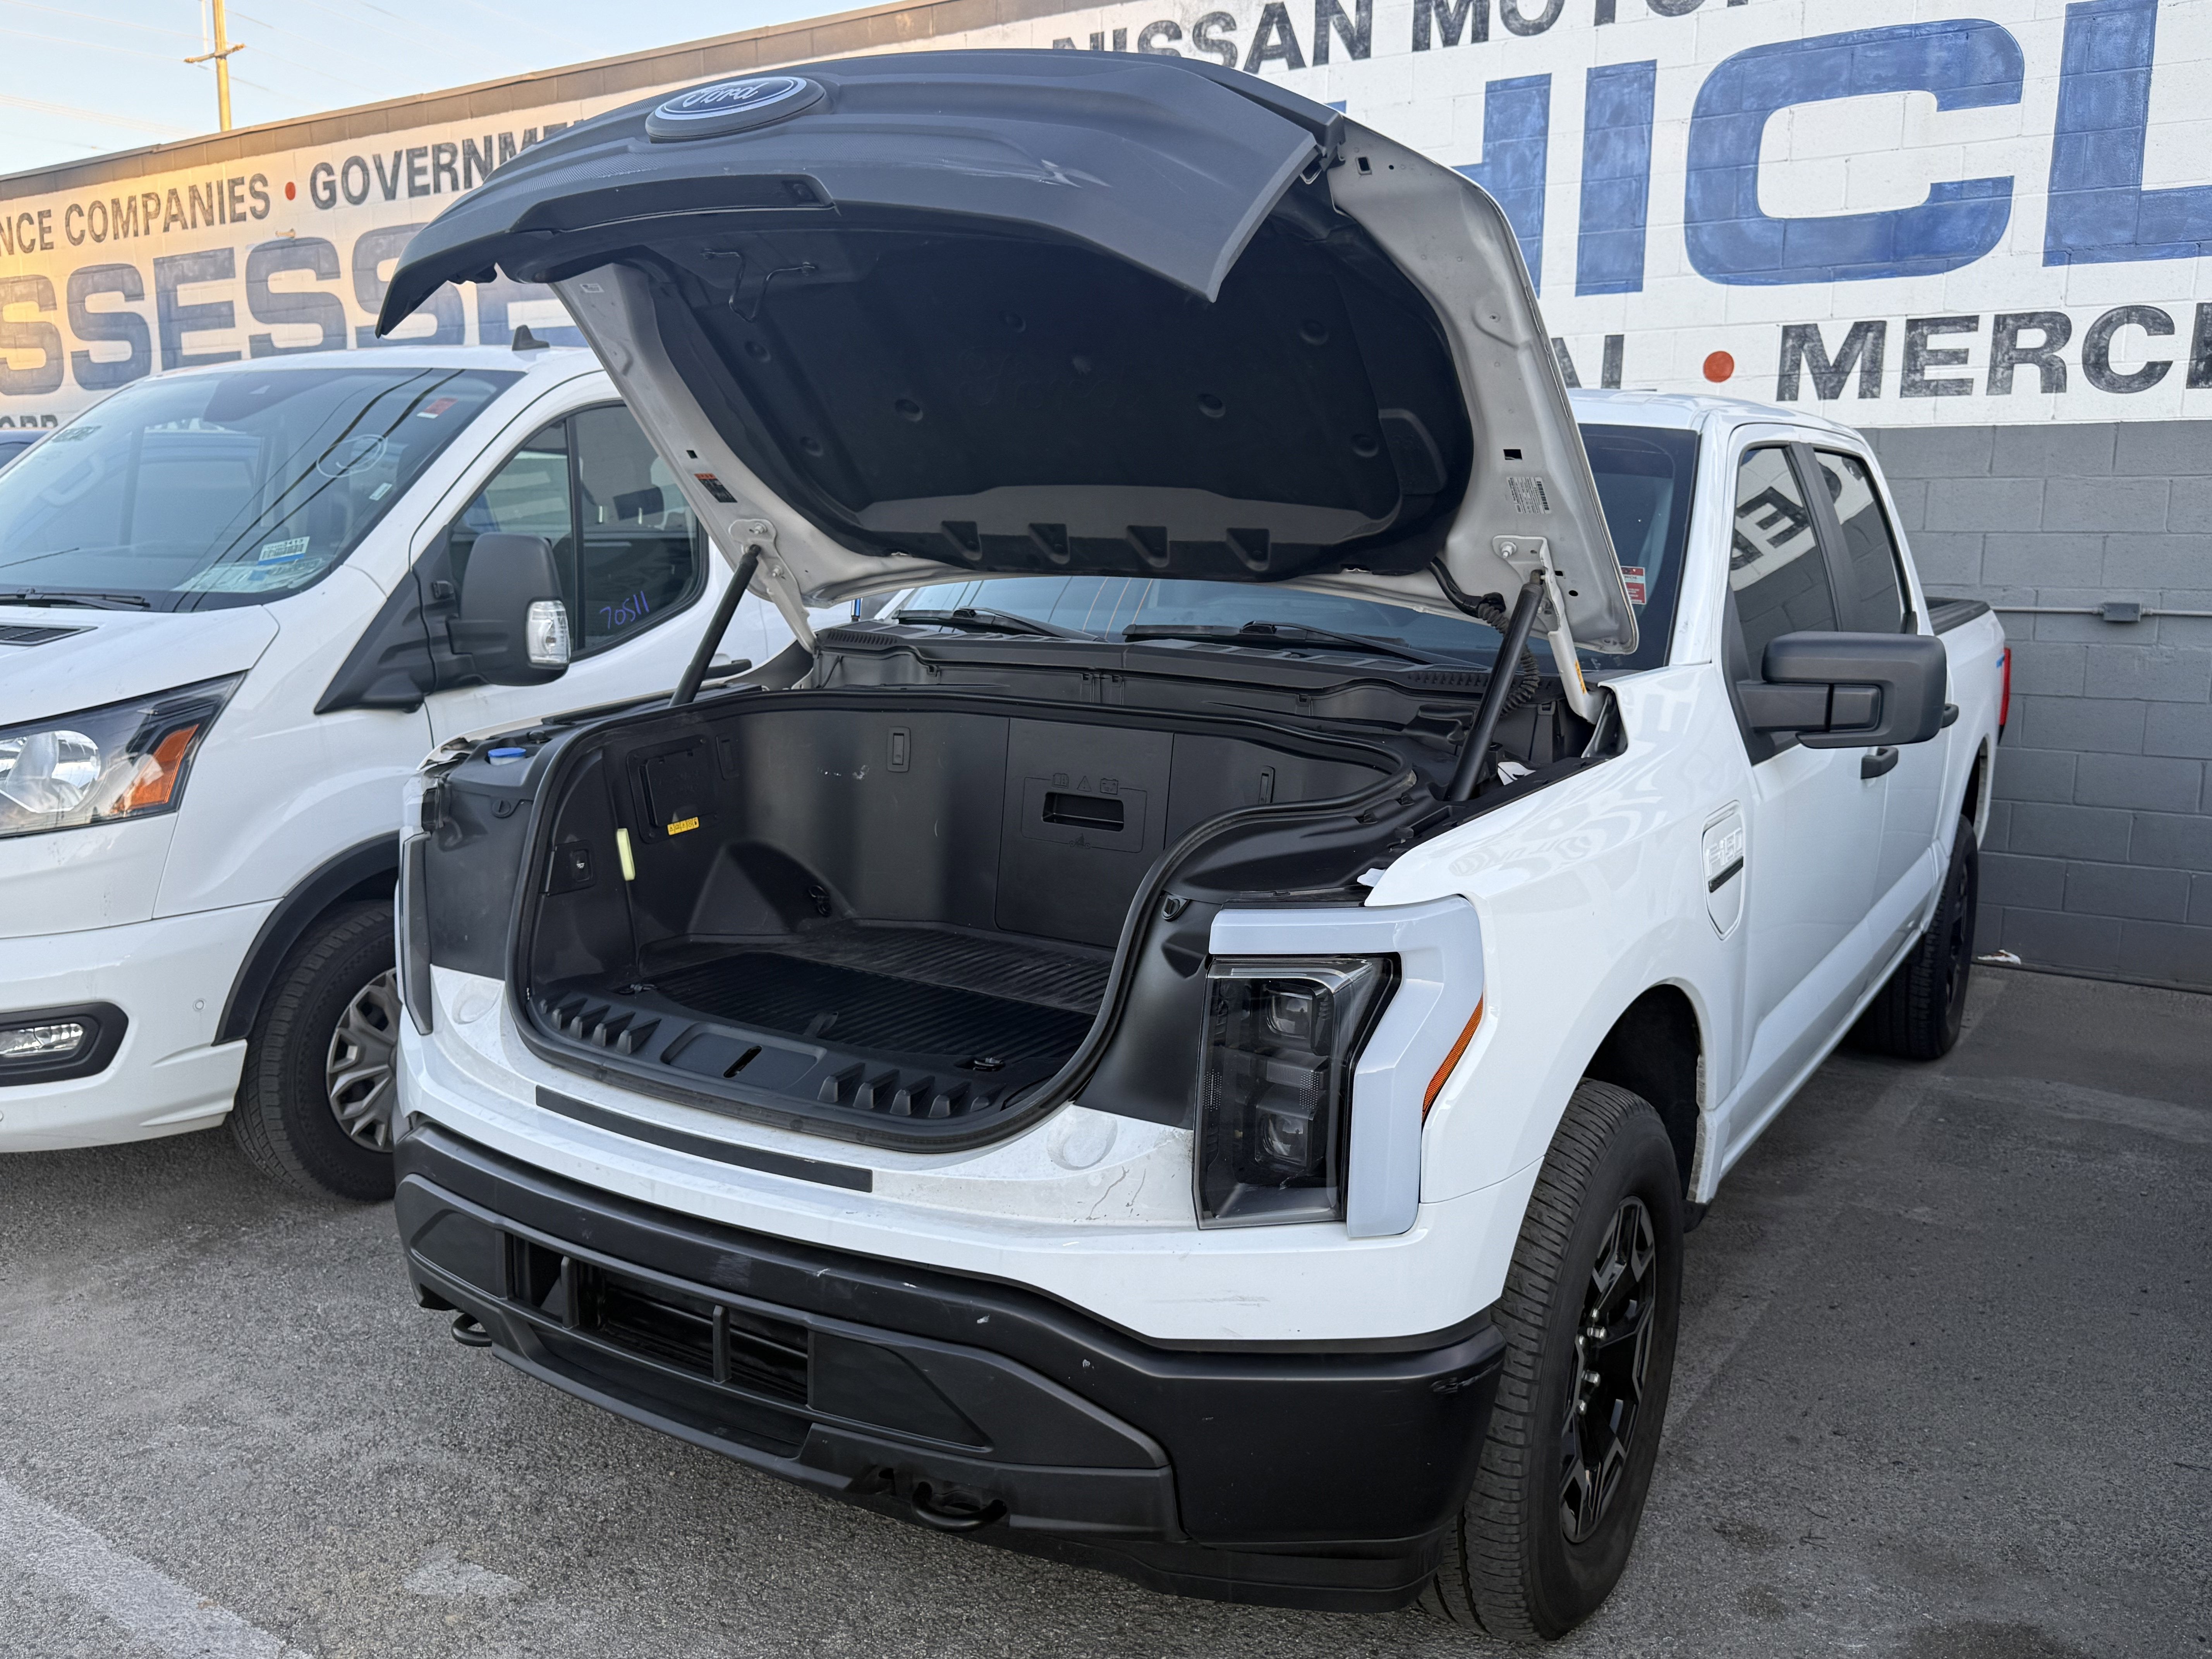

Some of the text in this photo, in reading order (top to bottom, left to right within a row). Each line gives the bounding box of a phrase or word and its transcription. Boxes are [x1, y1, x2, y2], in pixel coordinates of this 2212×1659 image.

[682, 82, 770, 108] Ford
[65, 173, 270, 246] COMPANIES
[310, 118, 583, 210] GOVERNM
[1053, 0, 1372, 72] SSAN
[600, 591, 649, 629] 70511
